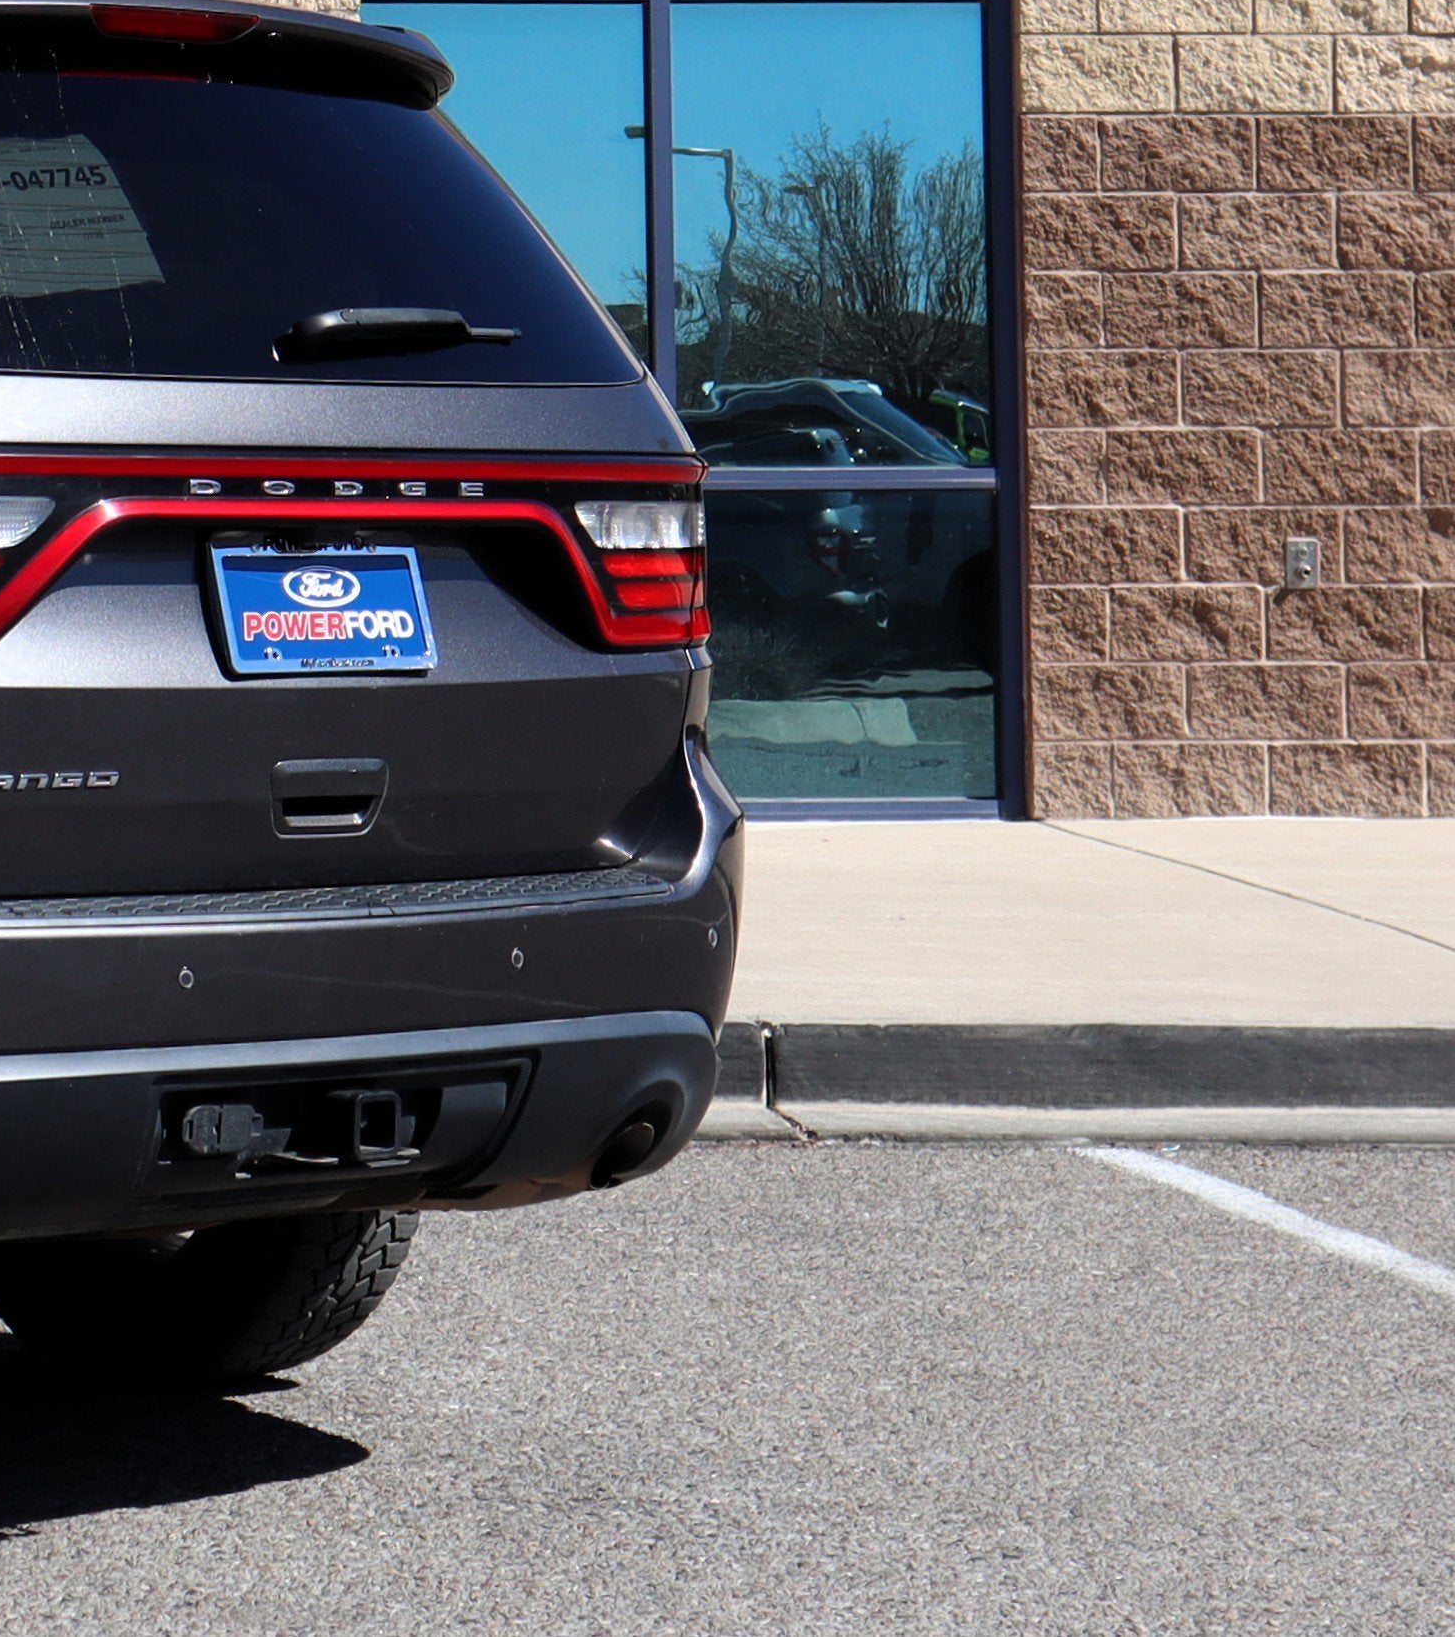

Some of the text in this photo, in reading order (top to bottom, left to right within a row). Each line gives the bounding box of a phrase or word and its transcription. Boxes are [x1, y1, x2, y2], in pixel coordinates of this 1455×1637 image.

[50, 213, 126, 230] DEALER NUMBER
[189, 478, 485, 497] DODGE
[298, 571, 346, 599] Ford
[243, 610, 414, 641] POWERFORD
